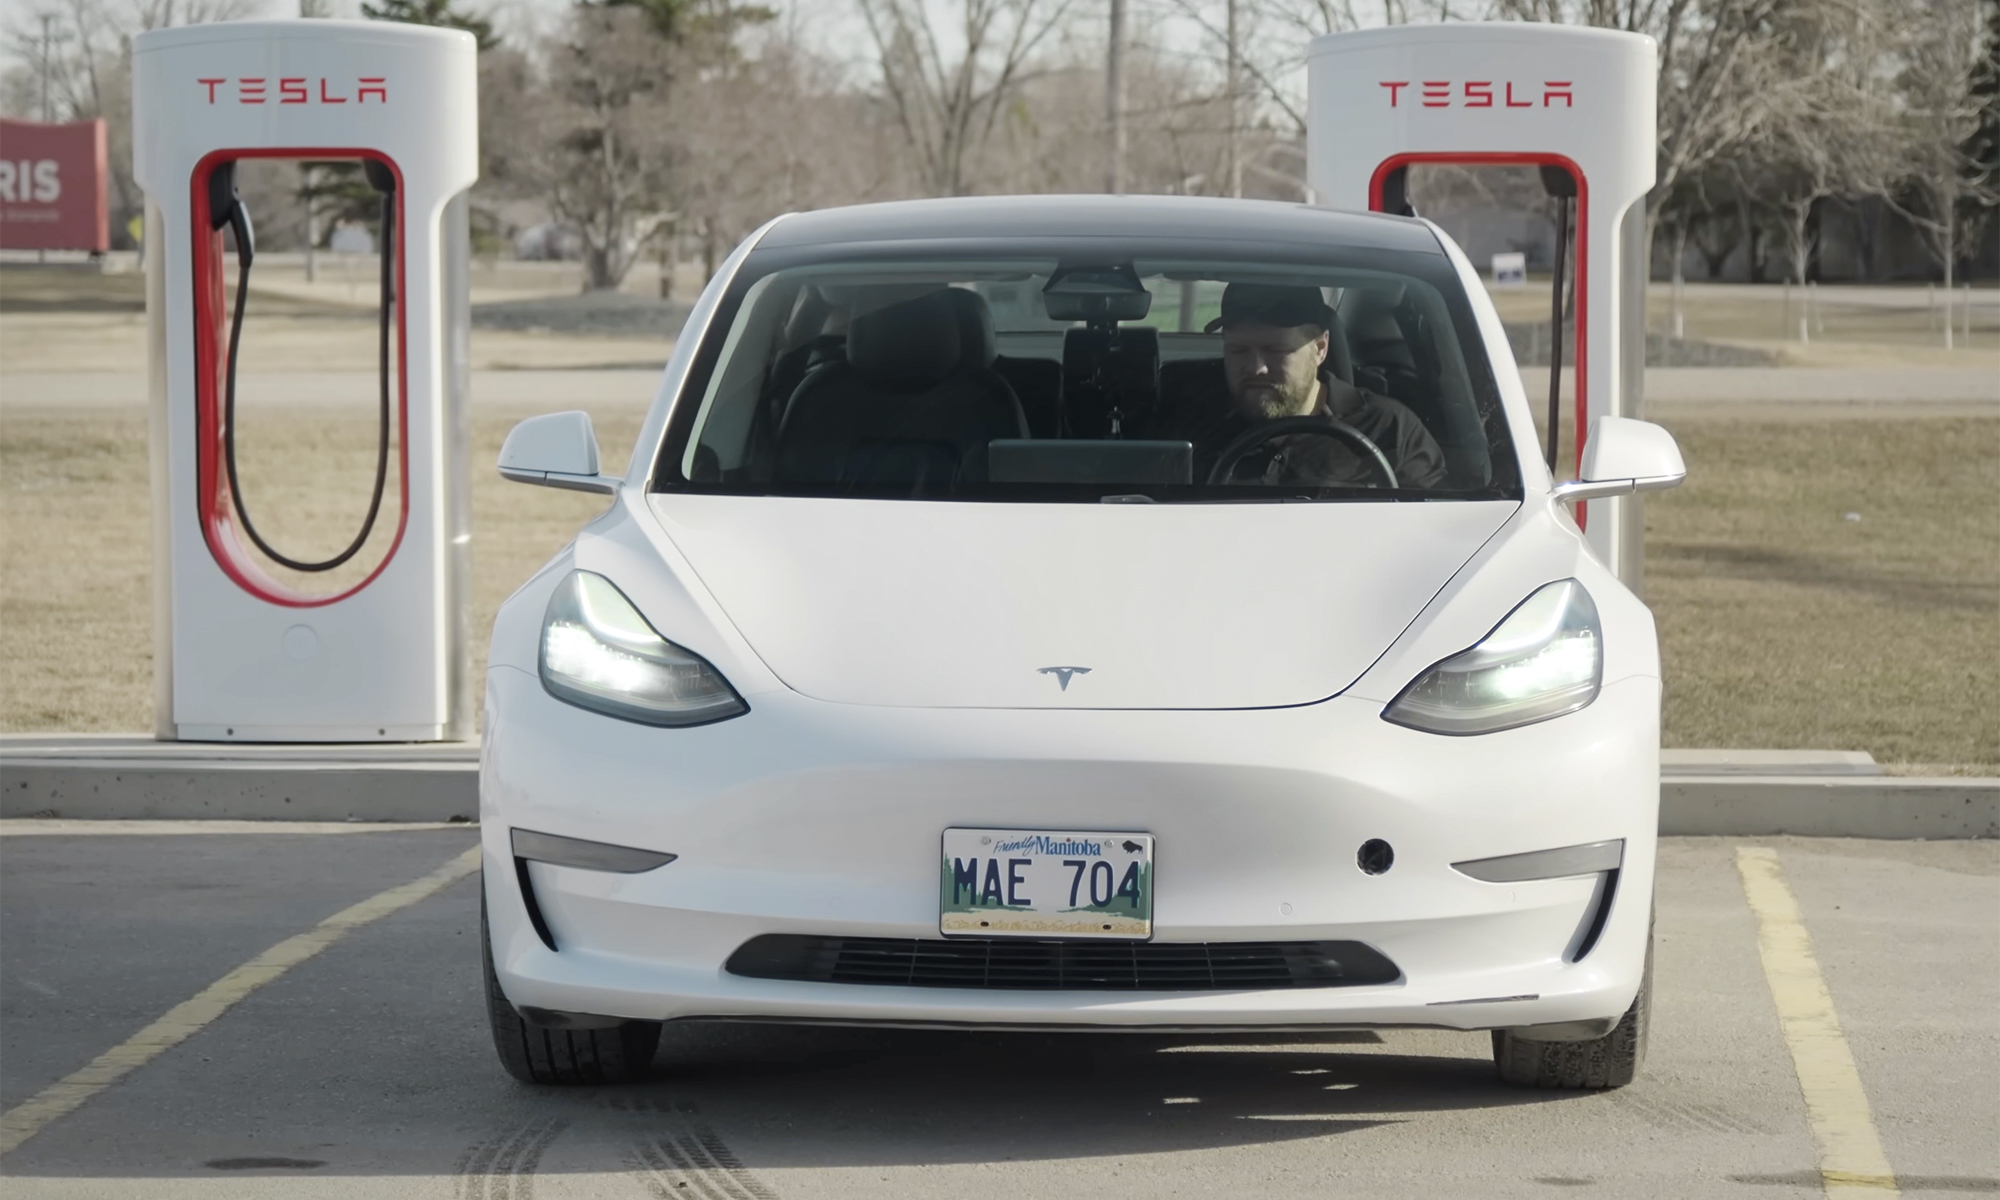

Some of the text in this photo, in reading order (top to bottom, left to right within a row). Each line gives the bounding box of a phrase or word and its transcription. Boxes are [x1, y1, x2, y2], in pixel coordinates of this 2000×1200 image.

[197, 78, 386, 104] TESLA
[1379, 81, 1573, 107] TESLA
[993, 835, 1102, 857] Friendly Manitoba
[953, 857, 1141, 908] MAE 704
